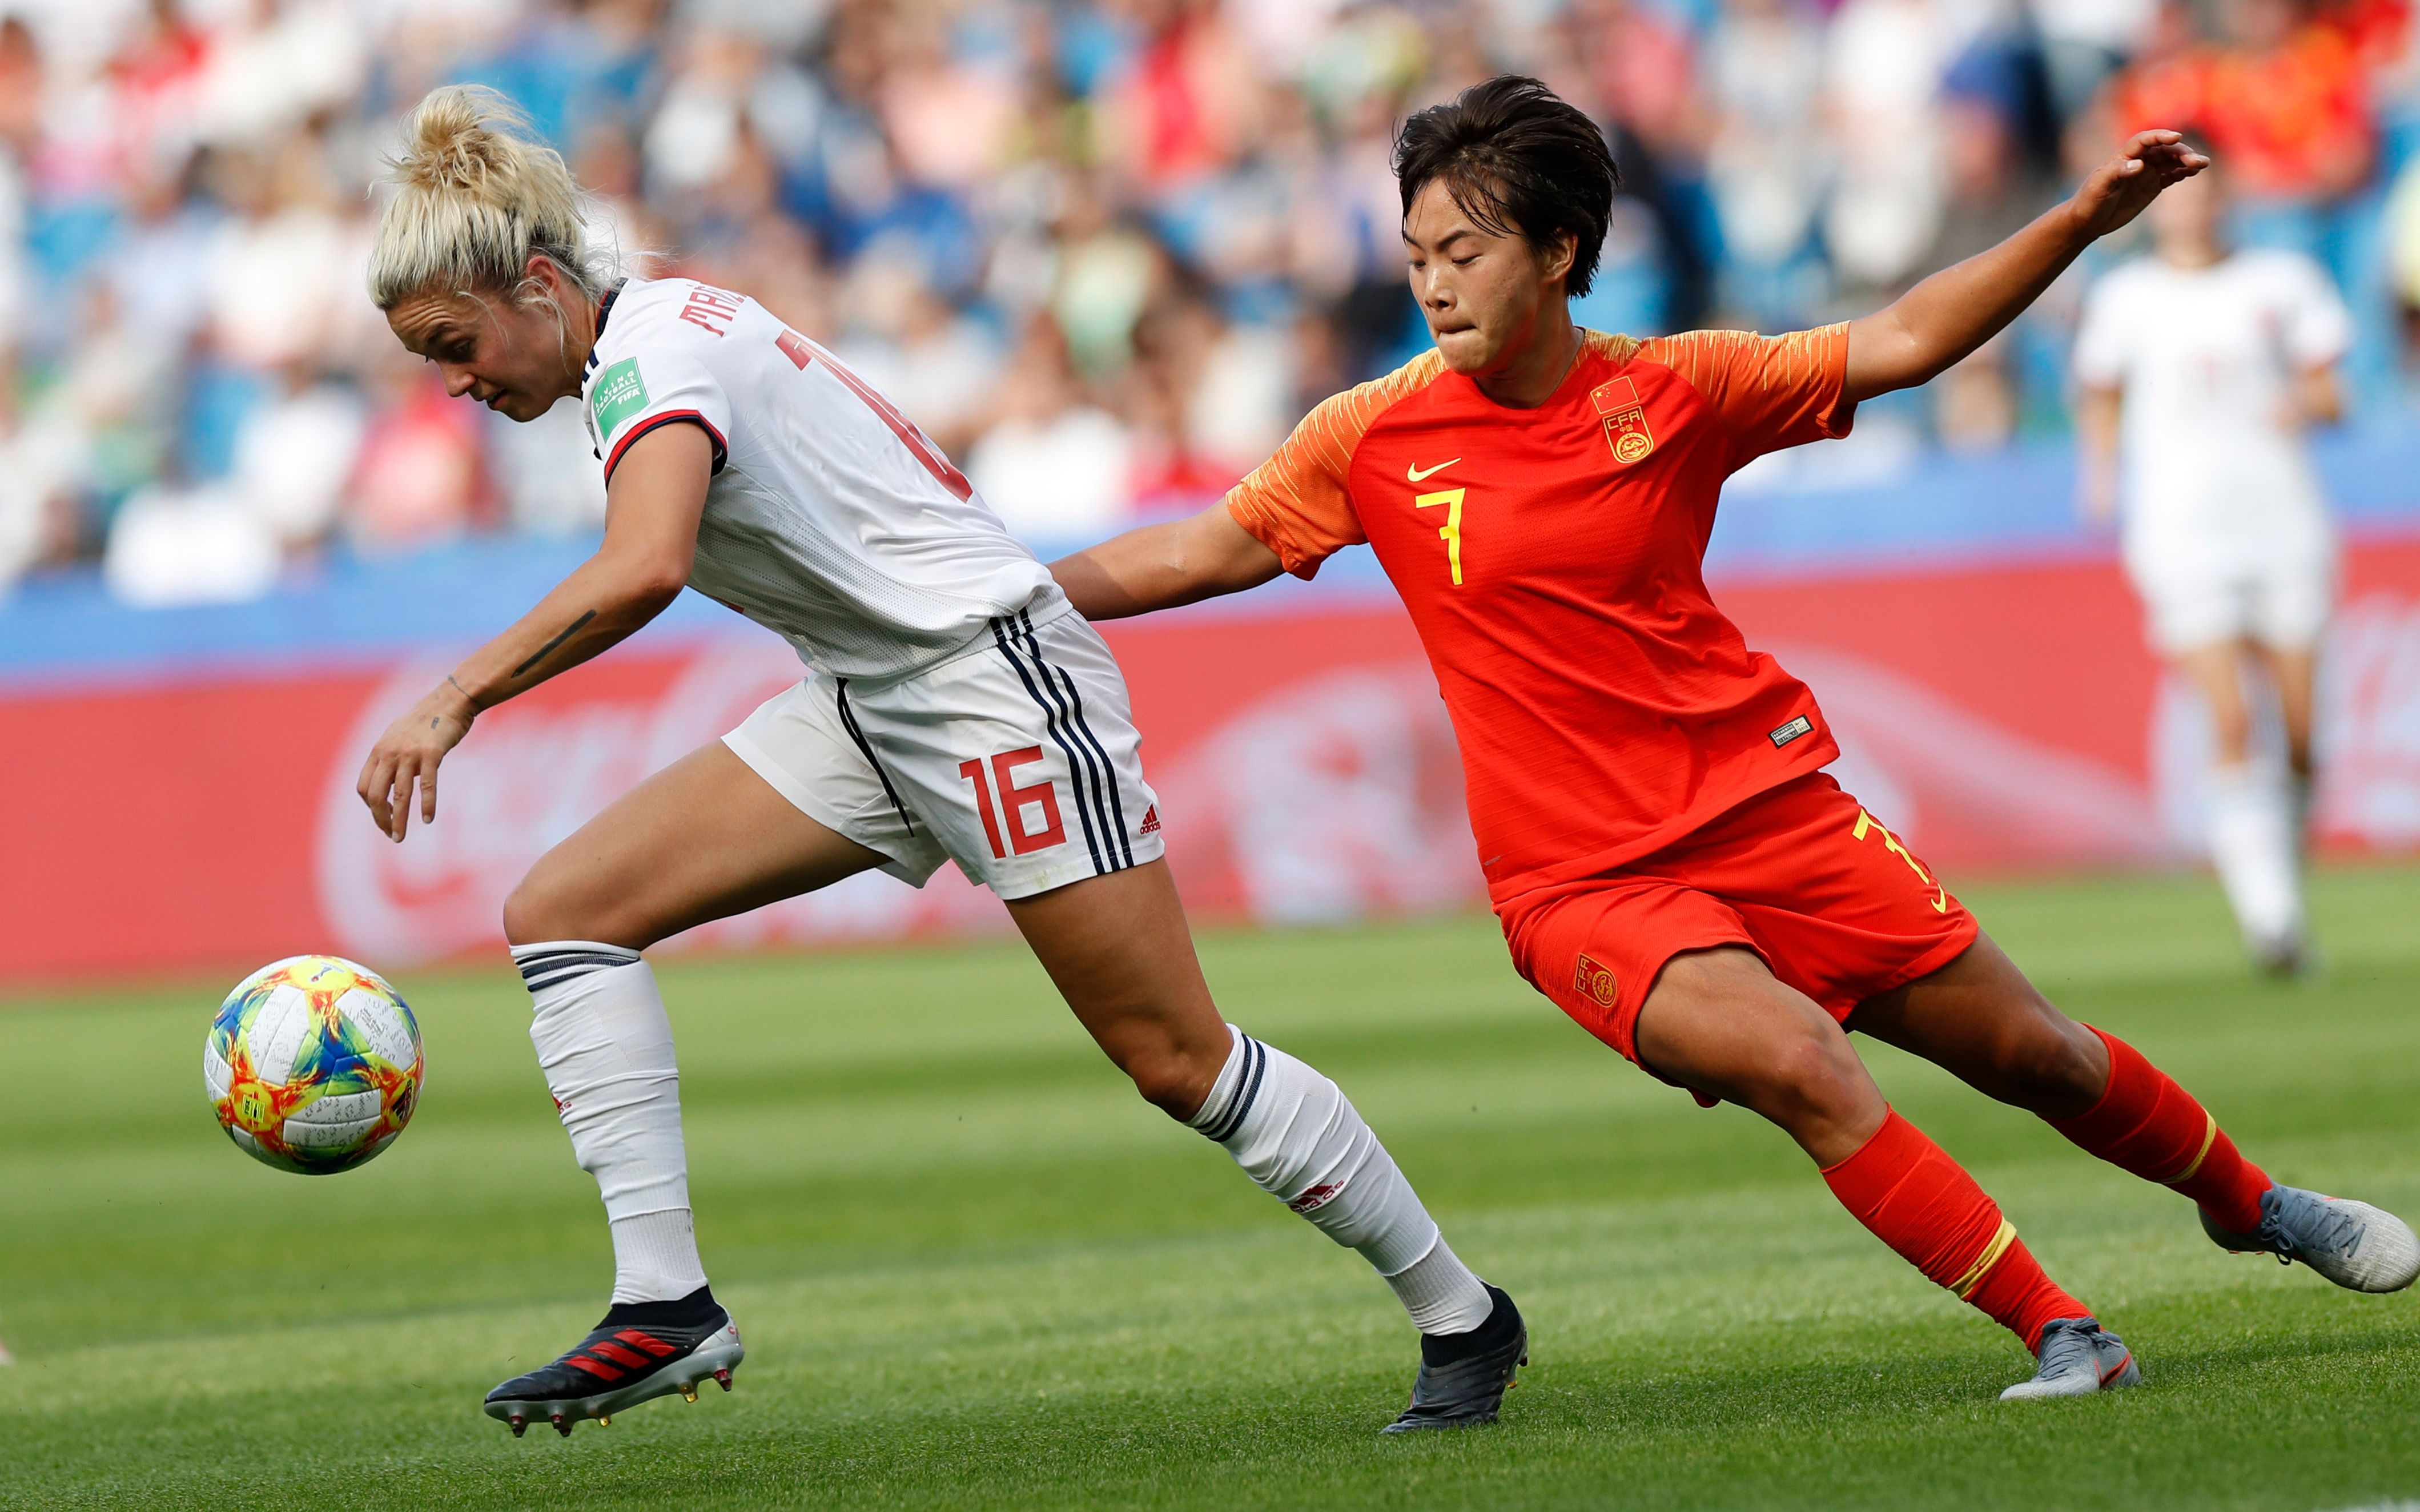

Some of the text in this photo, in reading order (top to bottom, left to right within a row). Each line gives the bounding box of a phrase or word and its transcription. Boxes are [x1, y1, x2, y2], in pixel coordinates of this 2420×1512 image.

[595, 370, 635, 408] LIVING
[596, 377, 637, 415] FOOTBALL
[617, 387, 641, 405] FIFA
[1606, 410, 1641, 430] CFA
[1415, 487, 1466, 586] 7
[958, 744, 1067, 859] 16
[1140, 821, 1161, 835] adidas
[1851, 807, 1929, 886] 7
[1577, 957, 1590, 991] CFA
